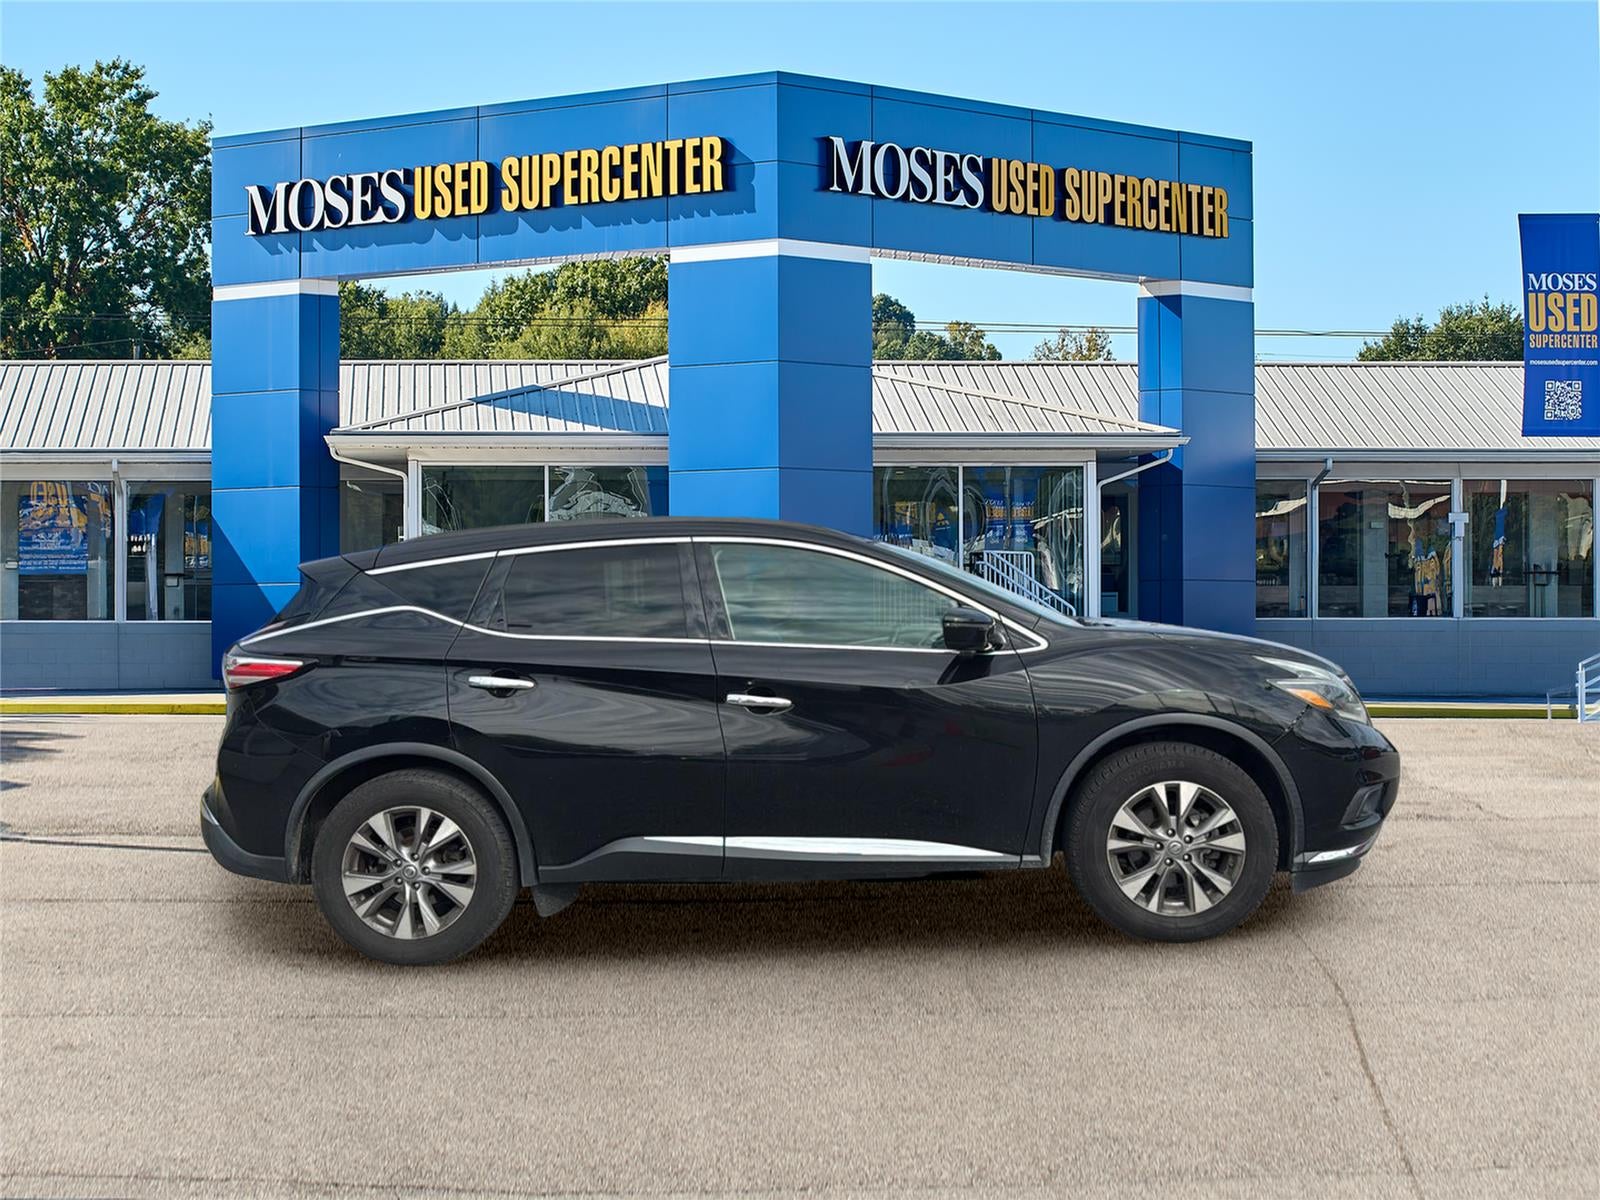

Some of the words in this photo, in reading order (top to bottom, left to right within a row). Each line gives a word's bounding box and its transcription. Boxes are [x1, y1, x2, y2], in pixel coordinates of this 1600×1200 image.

[245, 169, 408, 237] MOSES
[413, 161, 488, 220] USED
[501, 136, 723, 212] SUPERCENTER
[828, 136, 985, 209] MOSES
[990, 157, 1054, 217] USED
[1064, 167, 1229, 238] SUPERCENTER
[1528, 273, 1597, 291] MOSES
[1528, 292, 1598, 332] USED
[1529, 334, 1598, 348] SUPERCENTER
